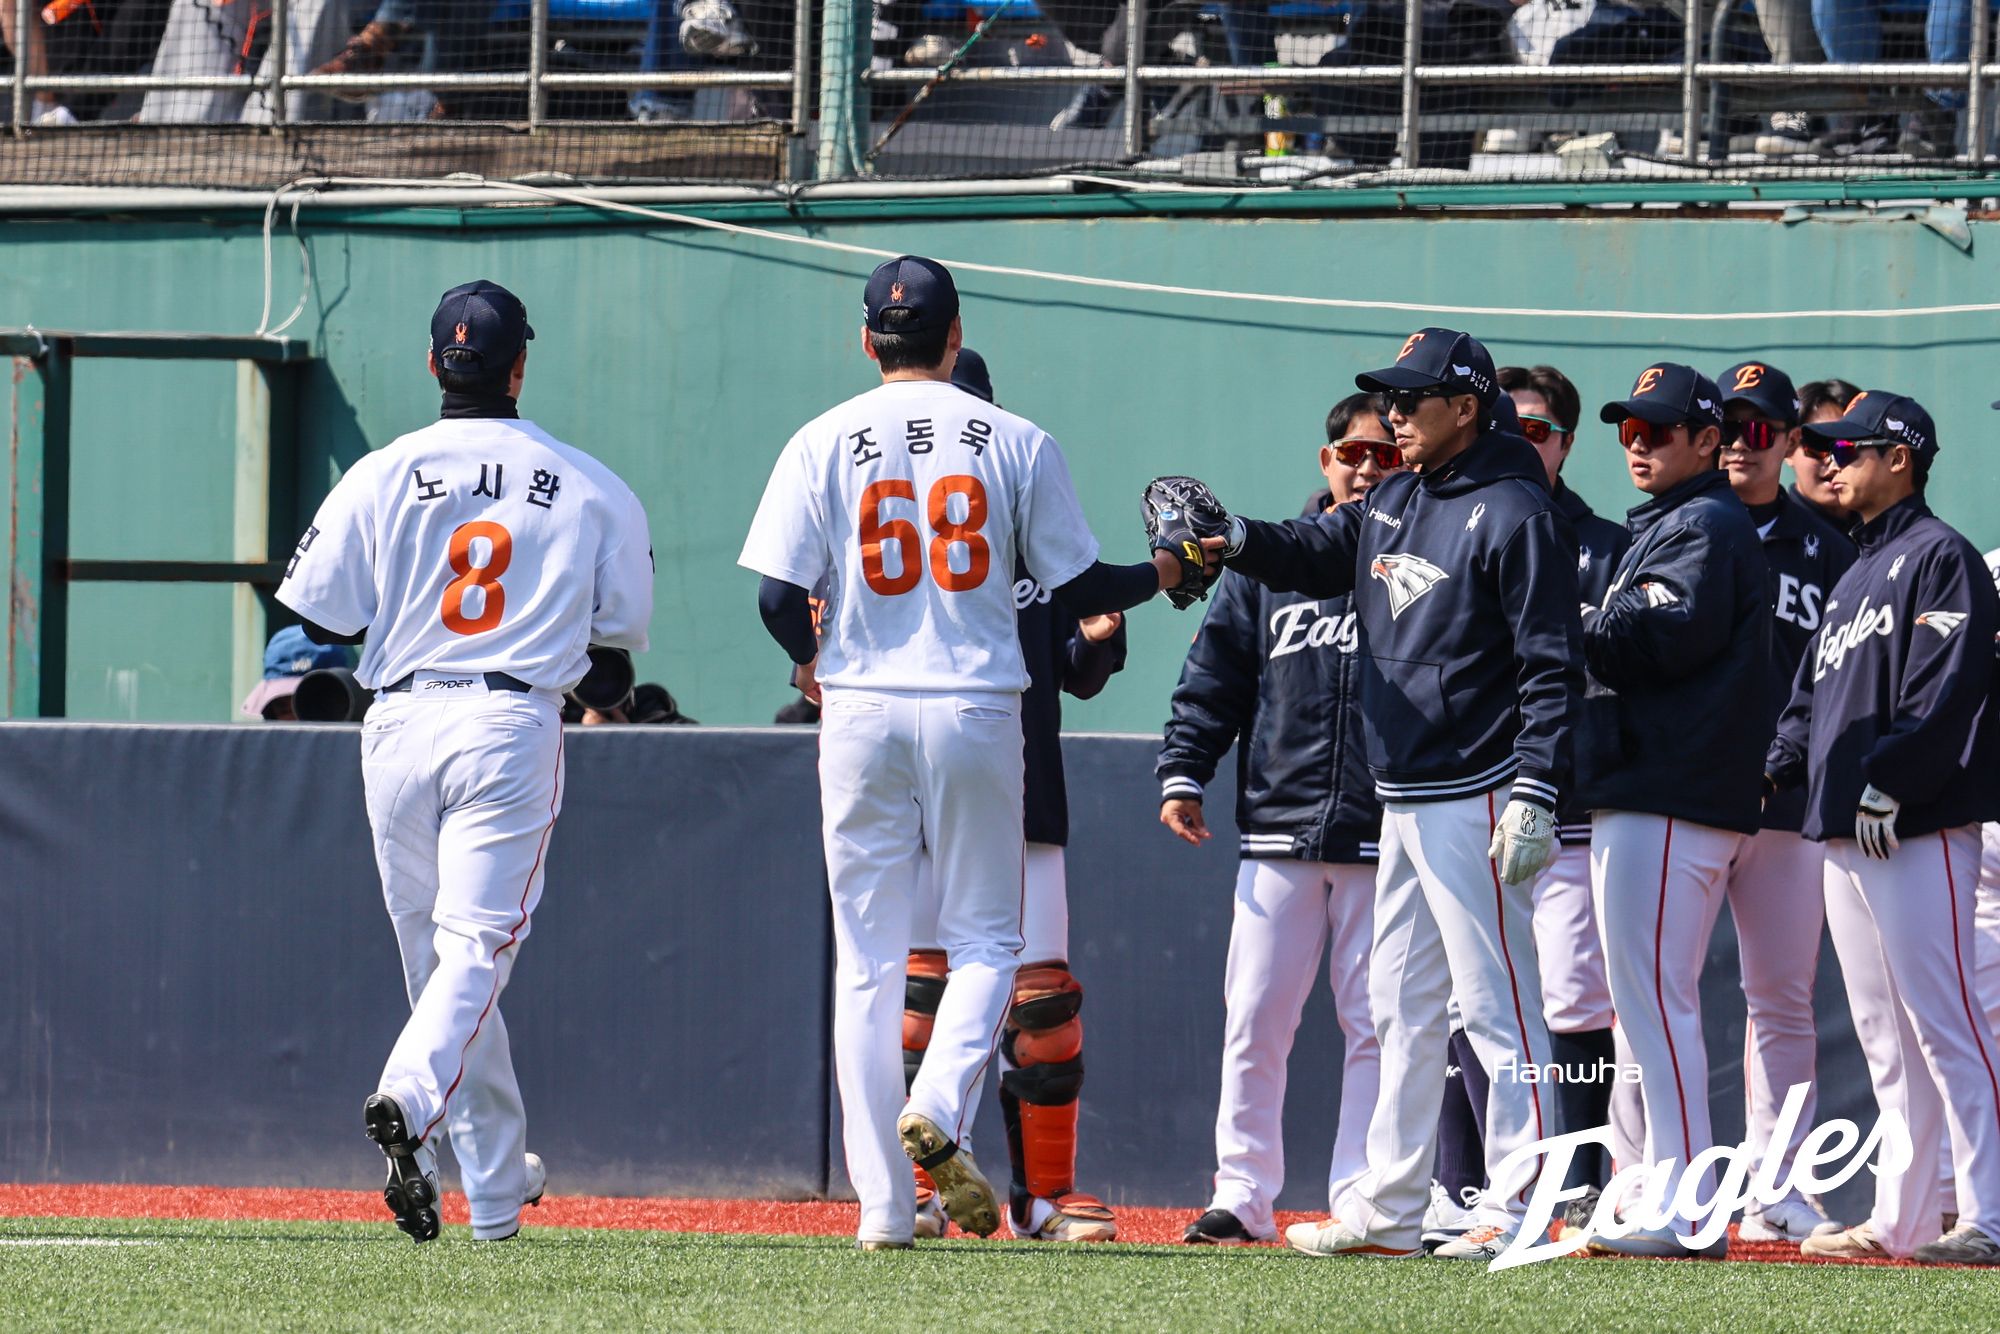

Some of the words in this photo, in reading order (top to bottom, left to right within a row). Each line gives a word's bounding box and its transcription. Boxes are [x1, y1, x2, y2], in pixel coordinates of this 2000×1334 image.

[1469, 376, 1488, 393] PLUS
[1471, 370, 1491, 387] LIFE
[1632, 368, 1665, 397] E
[1733, 364, 1765, 393] E
[1905, 426, 1926, 444] LIFE
[1369, 507, 1402, 530] Hanwh
[859, 474, 991, 597] 68
[440, 520, 513, 636] 8
[1012, 578, 1053, 610] es
[1775, 573, 1822, 632] ES
[1269, 600, 1359, 660] Eag
[1813, 596, 1895, 684] Eagles
[424, 679, 474, 690] SPYDER
